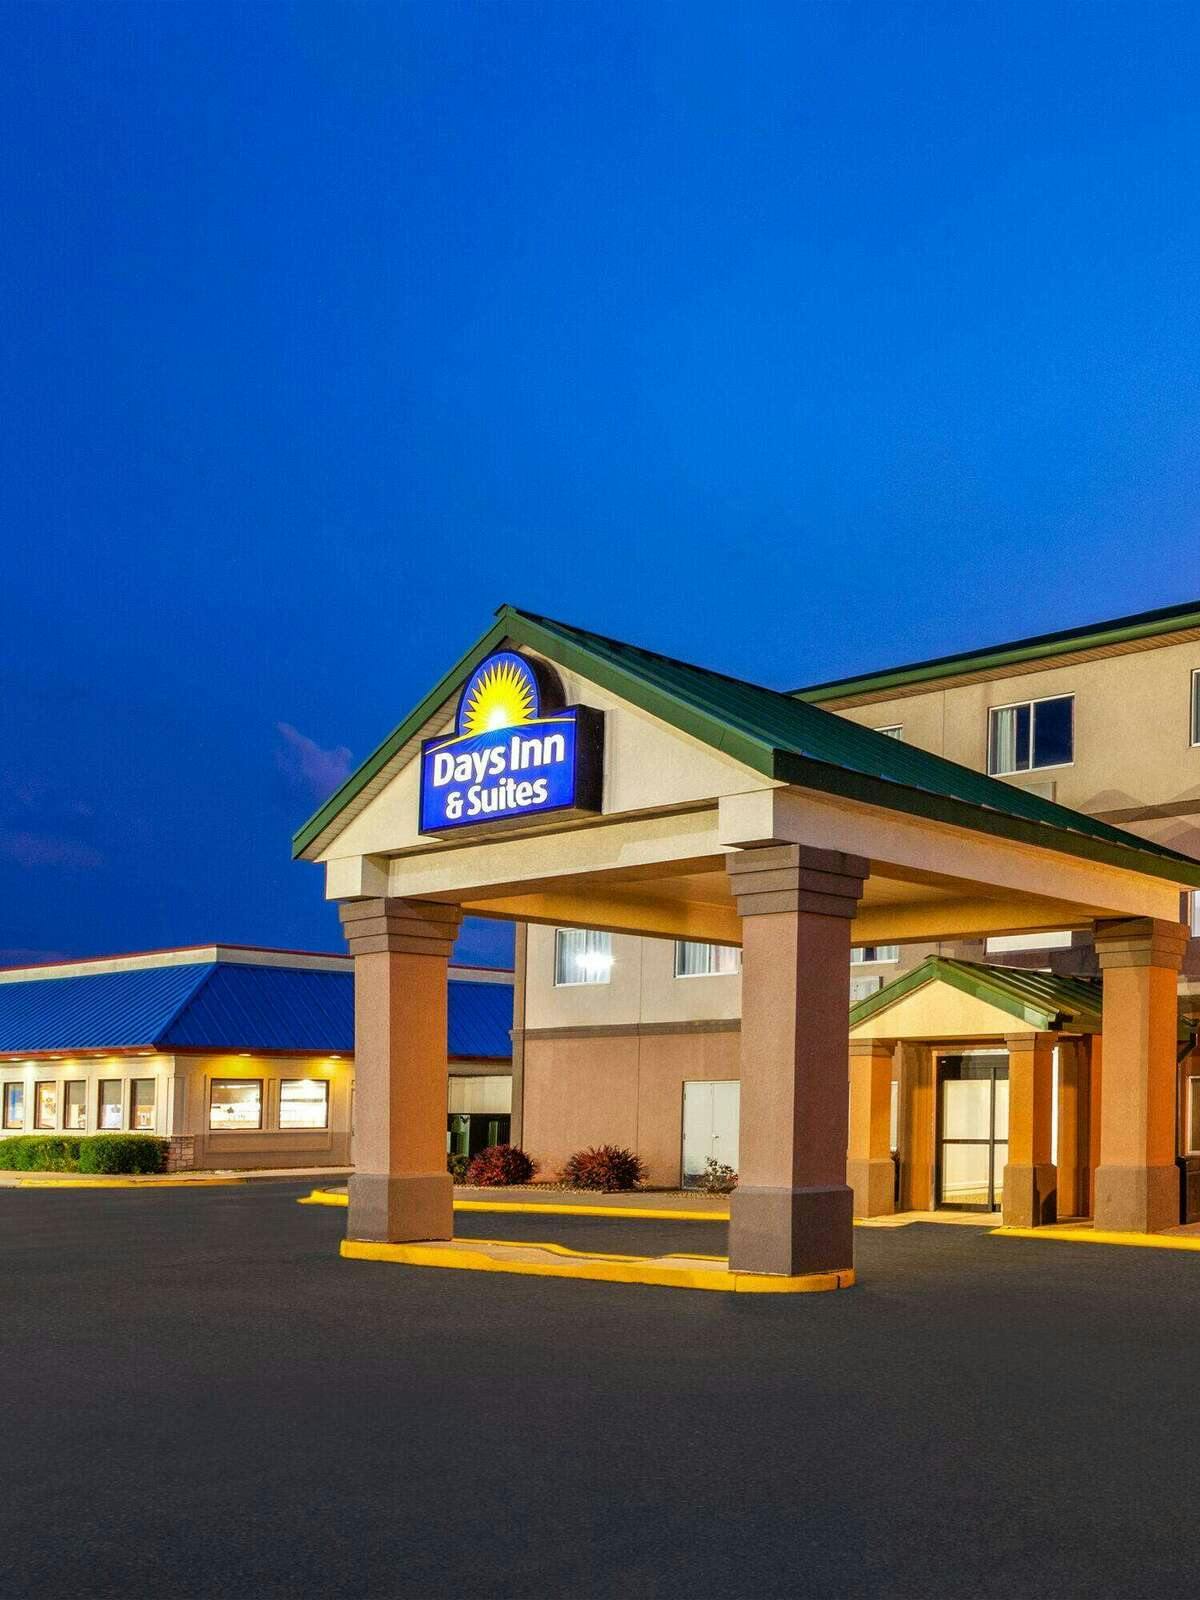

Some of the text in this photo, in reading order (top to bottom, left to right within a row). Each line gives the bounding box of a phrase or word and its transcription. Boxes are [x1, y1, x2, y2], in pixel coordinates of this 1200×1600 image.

[433, 733, 565, 787] Days Inn
[445, 777, 548, 819] & Suites
